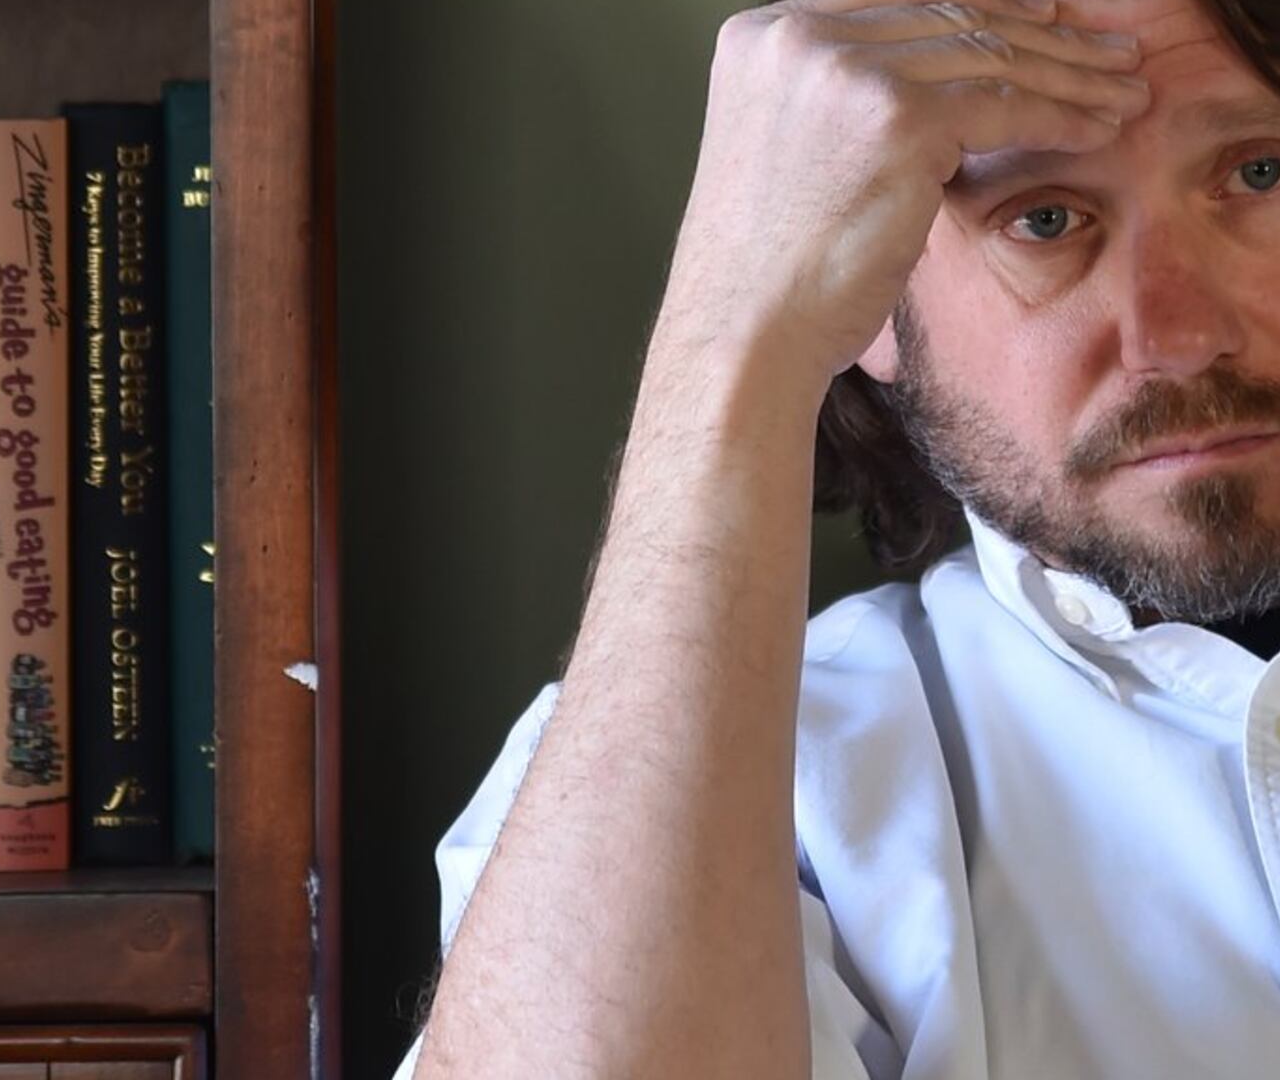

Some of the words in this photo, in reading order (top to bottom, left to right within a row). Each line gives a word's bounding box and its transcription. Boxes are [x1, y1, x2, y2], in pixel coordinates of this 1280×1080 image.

[10, 132, 65, 338] Zingerman's
[81, 185, 104, 224] Keys
[87, 227, 104, 244] to
[116, 142, 152, 284] Become
[84, 247, 105, 329] Improving
[117, 296, 143, 317] a
[87, 333, 106, 370] Your
[118, 324, 153, 437] Better
[0, 367, 37, 419] to
[85, 407, 108, 452] Every
[84, 455, 108, 488] Day
[119, 444, 155, 518] You
[6, 518, 60, 636] eating
[105, 547, 138, 619] JOEL
[111, 628, 139, 742] OSTEEN
